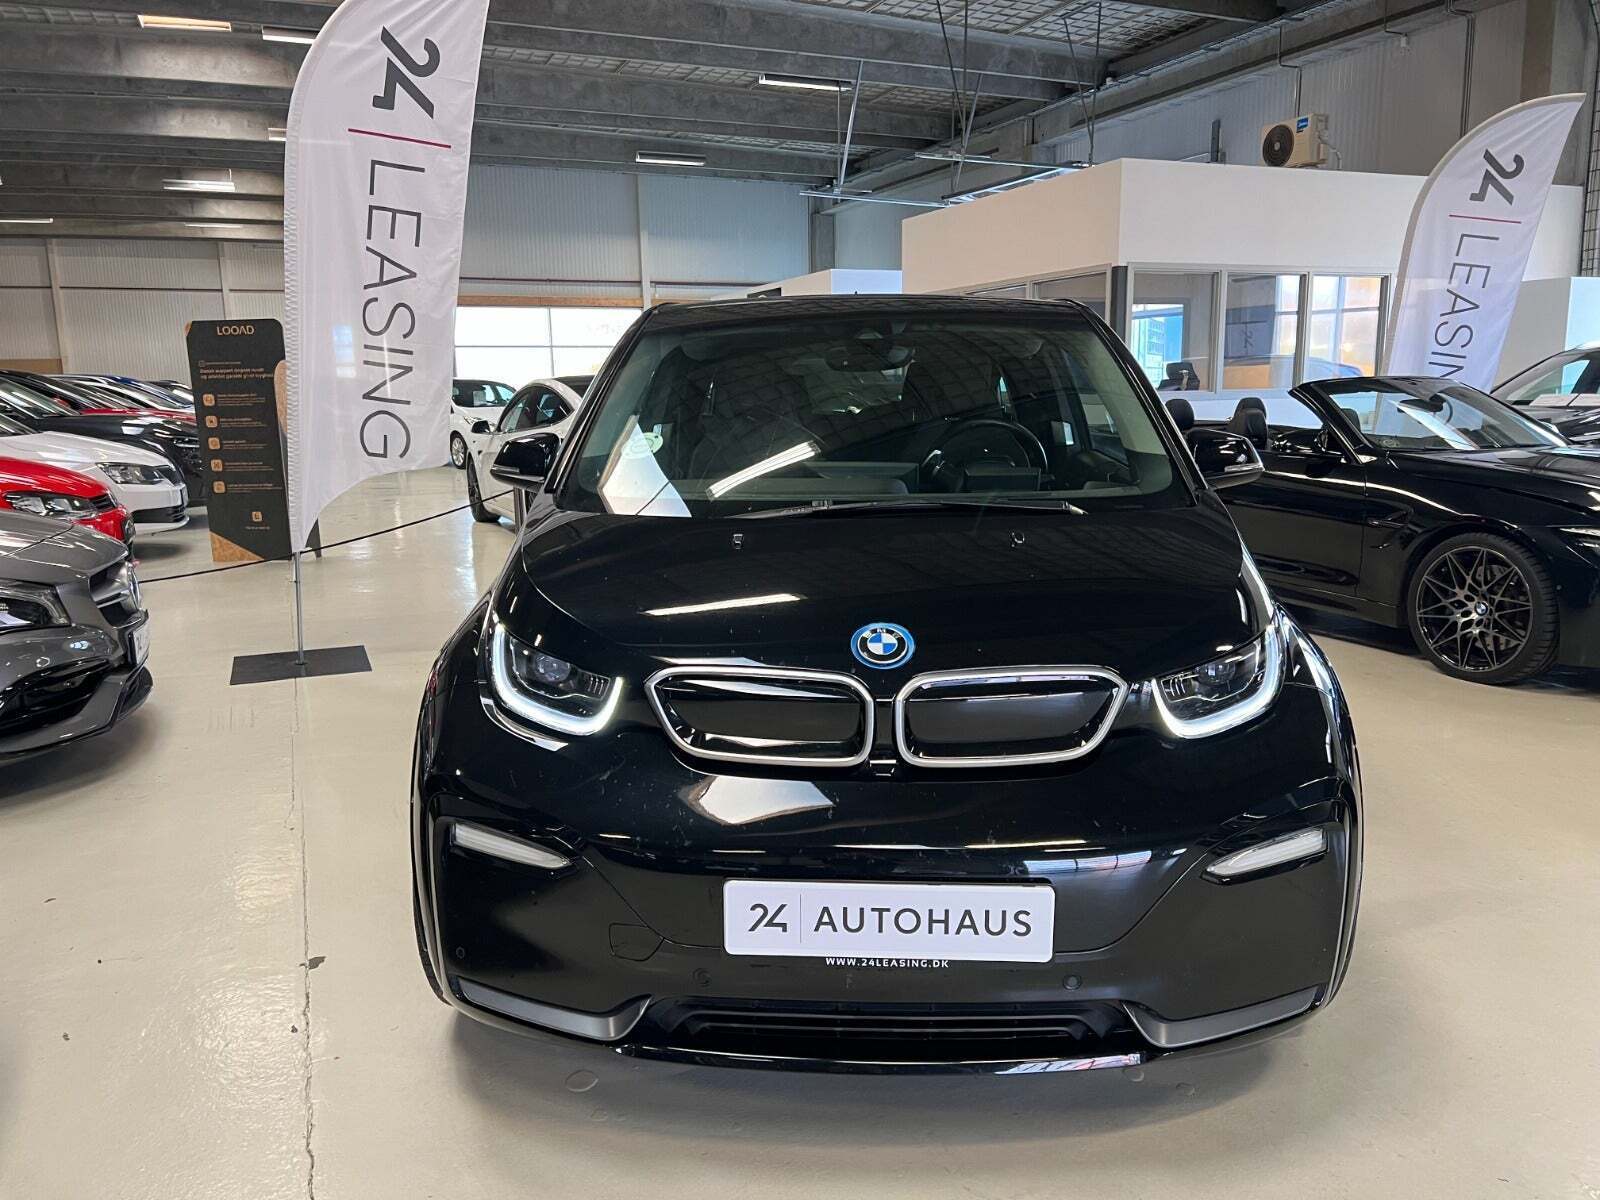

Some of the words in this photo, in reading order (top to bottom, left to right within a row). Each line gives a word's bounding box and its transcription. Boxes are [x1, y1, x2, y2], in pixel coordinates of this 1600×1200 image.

[372, 25, 442, 119] 24
[1469, 148, 1525, 206] 24
[216, 325, 255, 336] LOOAD
[359, 158, 426, 459] LEASING
[1428, 233, 1500, 378] LEASIN
[748, 903, 788, 933] 24
[813, 906, 1032, 937] AUTOHAUS
[825, 957, 949, 969] WWW.24LEASING.DK
